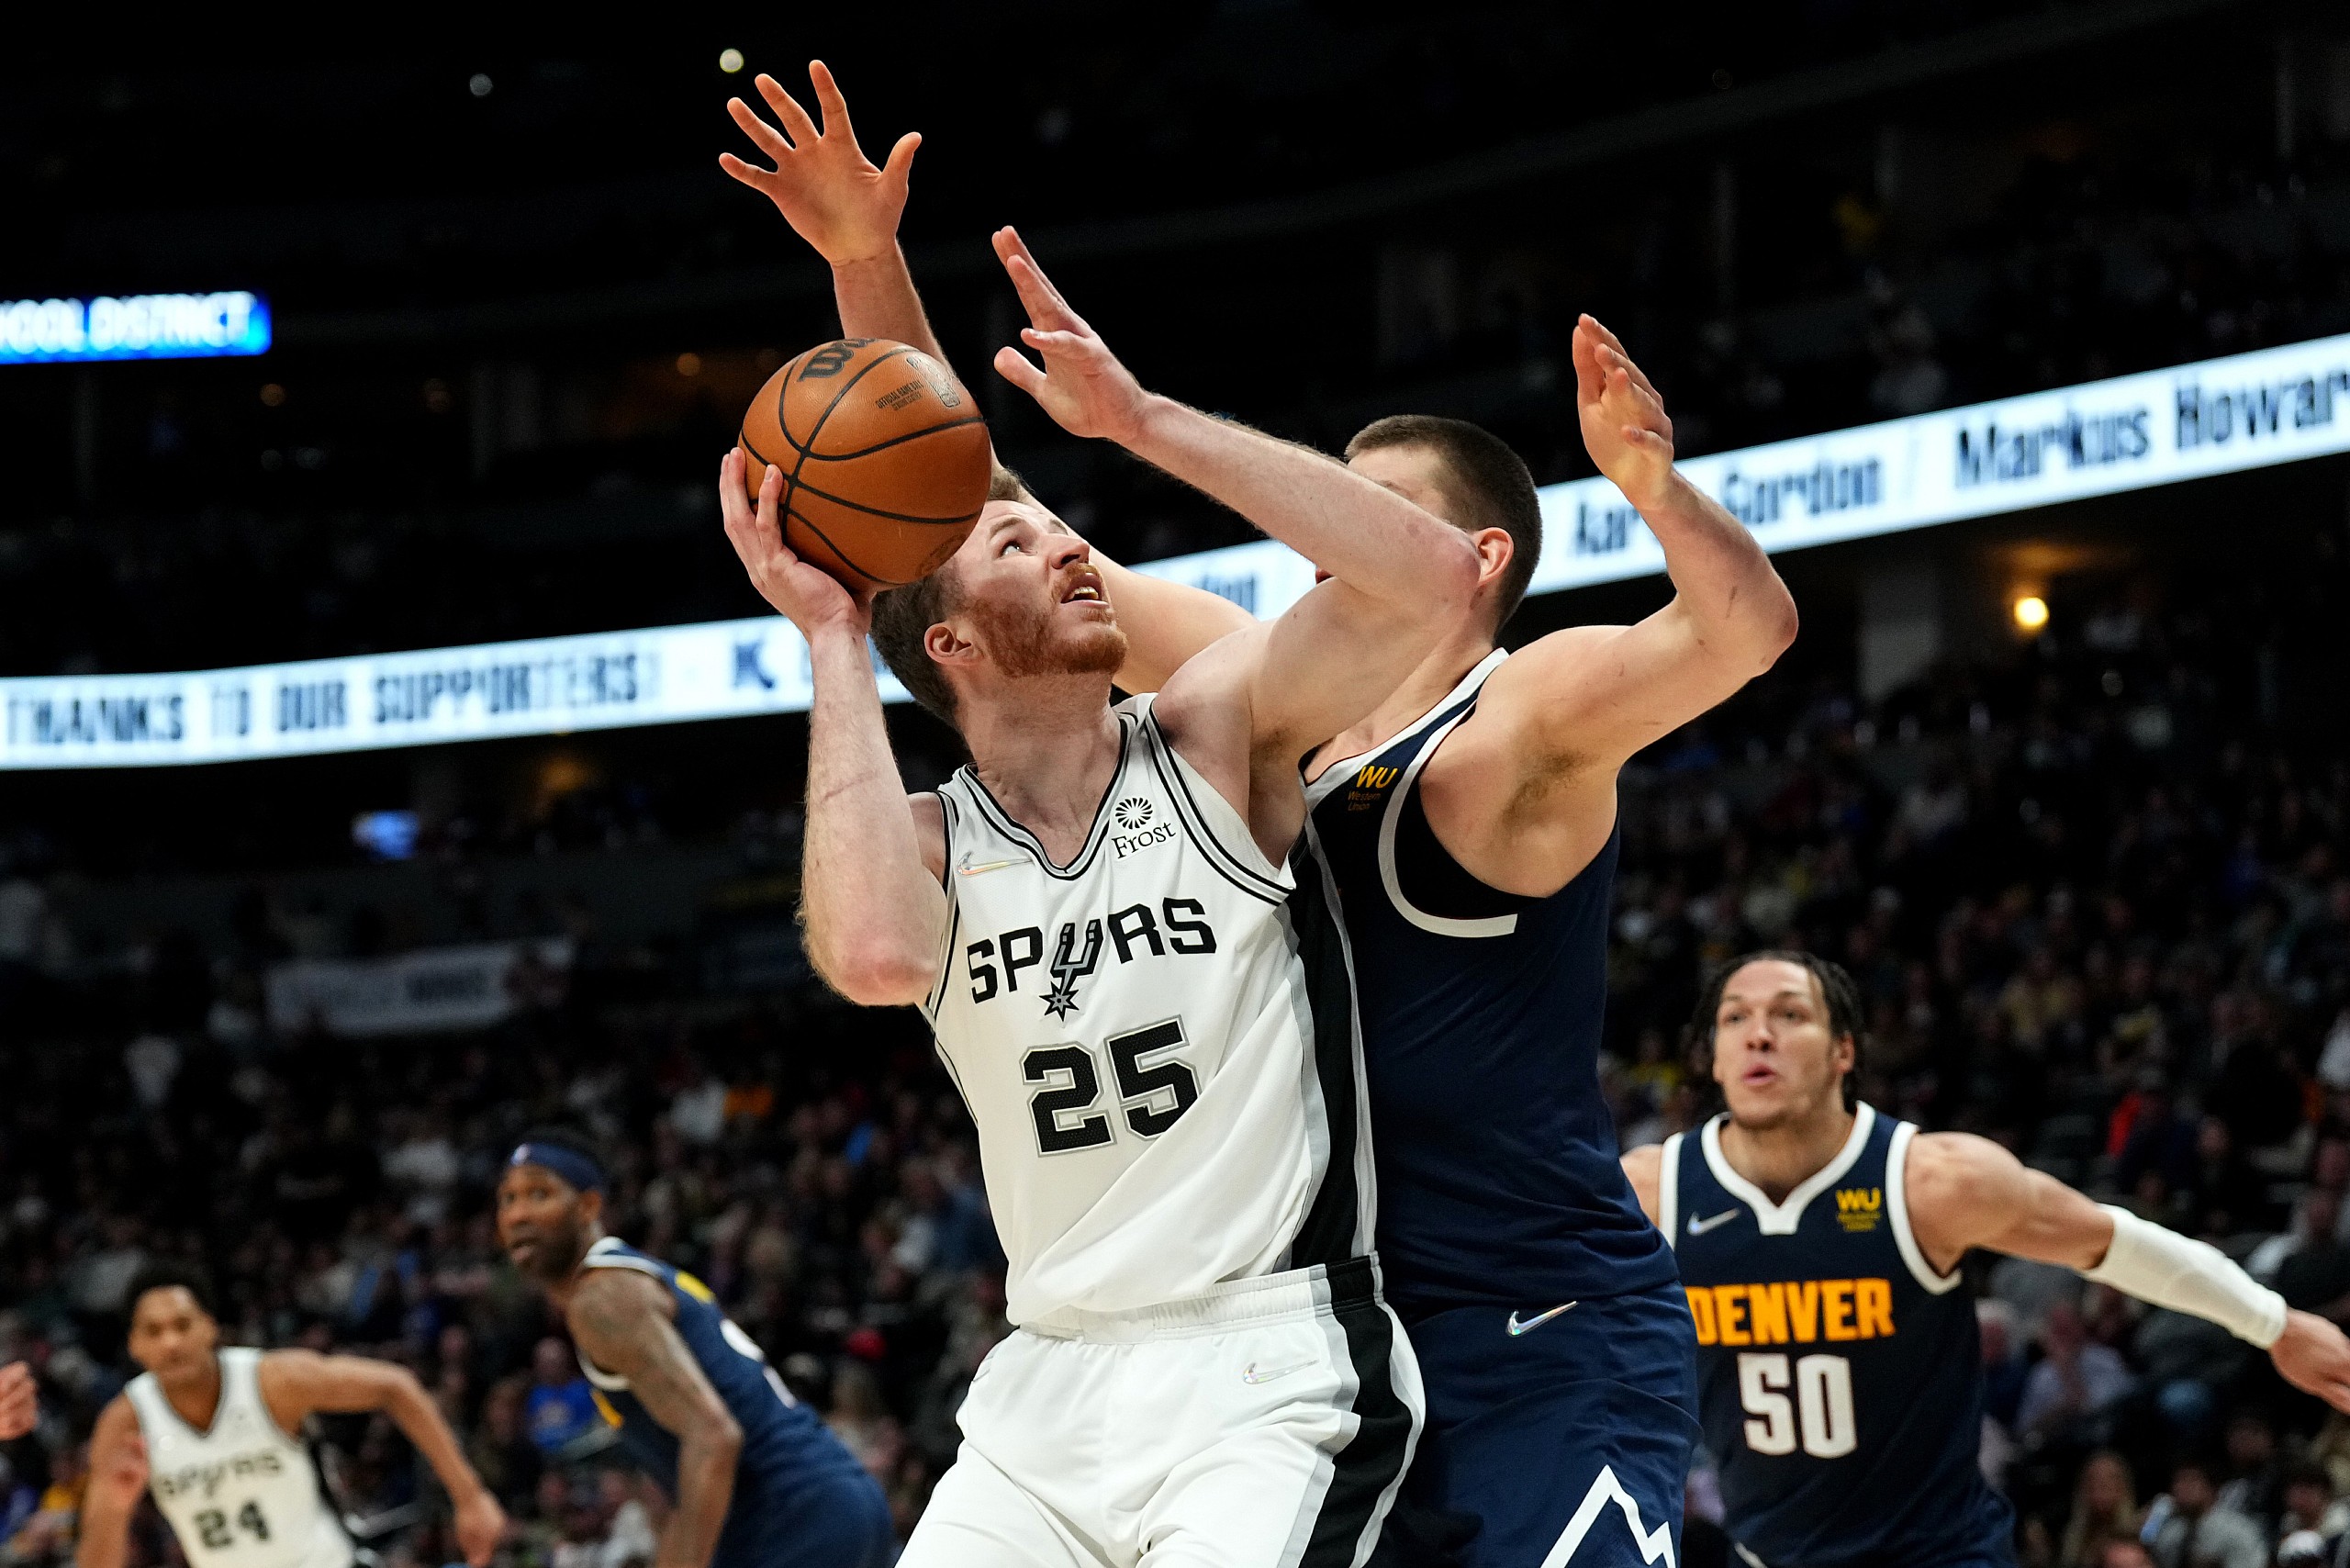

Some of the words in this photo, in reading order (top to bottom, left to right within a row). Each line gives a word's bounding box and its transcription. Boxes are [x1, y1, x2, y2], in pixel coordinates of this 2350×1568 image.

[88, 290, 256, 352] DISTRICT
[1955, 404, 2150, 488] Markus
[8, 694, 185, 745] THANKS
[279, 679, 347, 734] OUR
[1357, 766, 1398, 788] WU
[1111, 822, 1177, 859] Frost
[967, 897, 1217, 1020] SPURS
[1019, 1014, 1203, 1157] 25
[1684, 1277, 1897, 1347] DENVER
[1737, 1352, 1858, 1459] 50
[194, 1500, 271, 1549] 24
